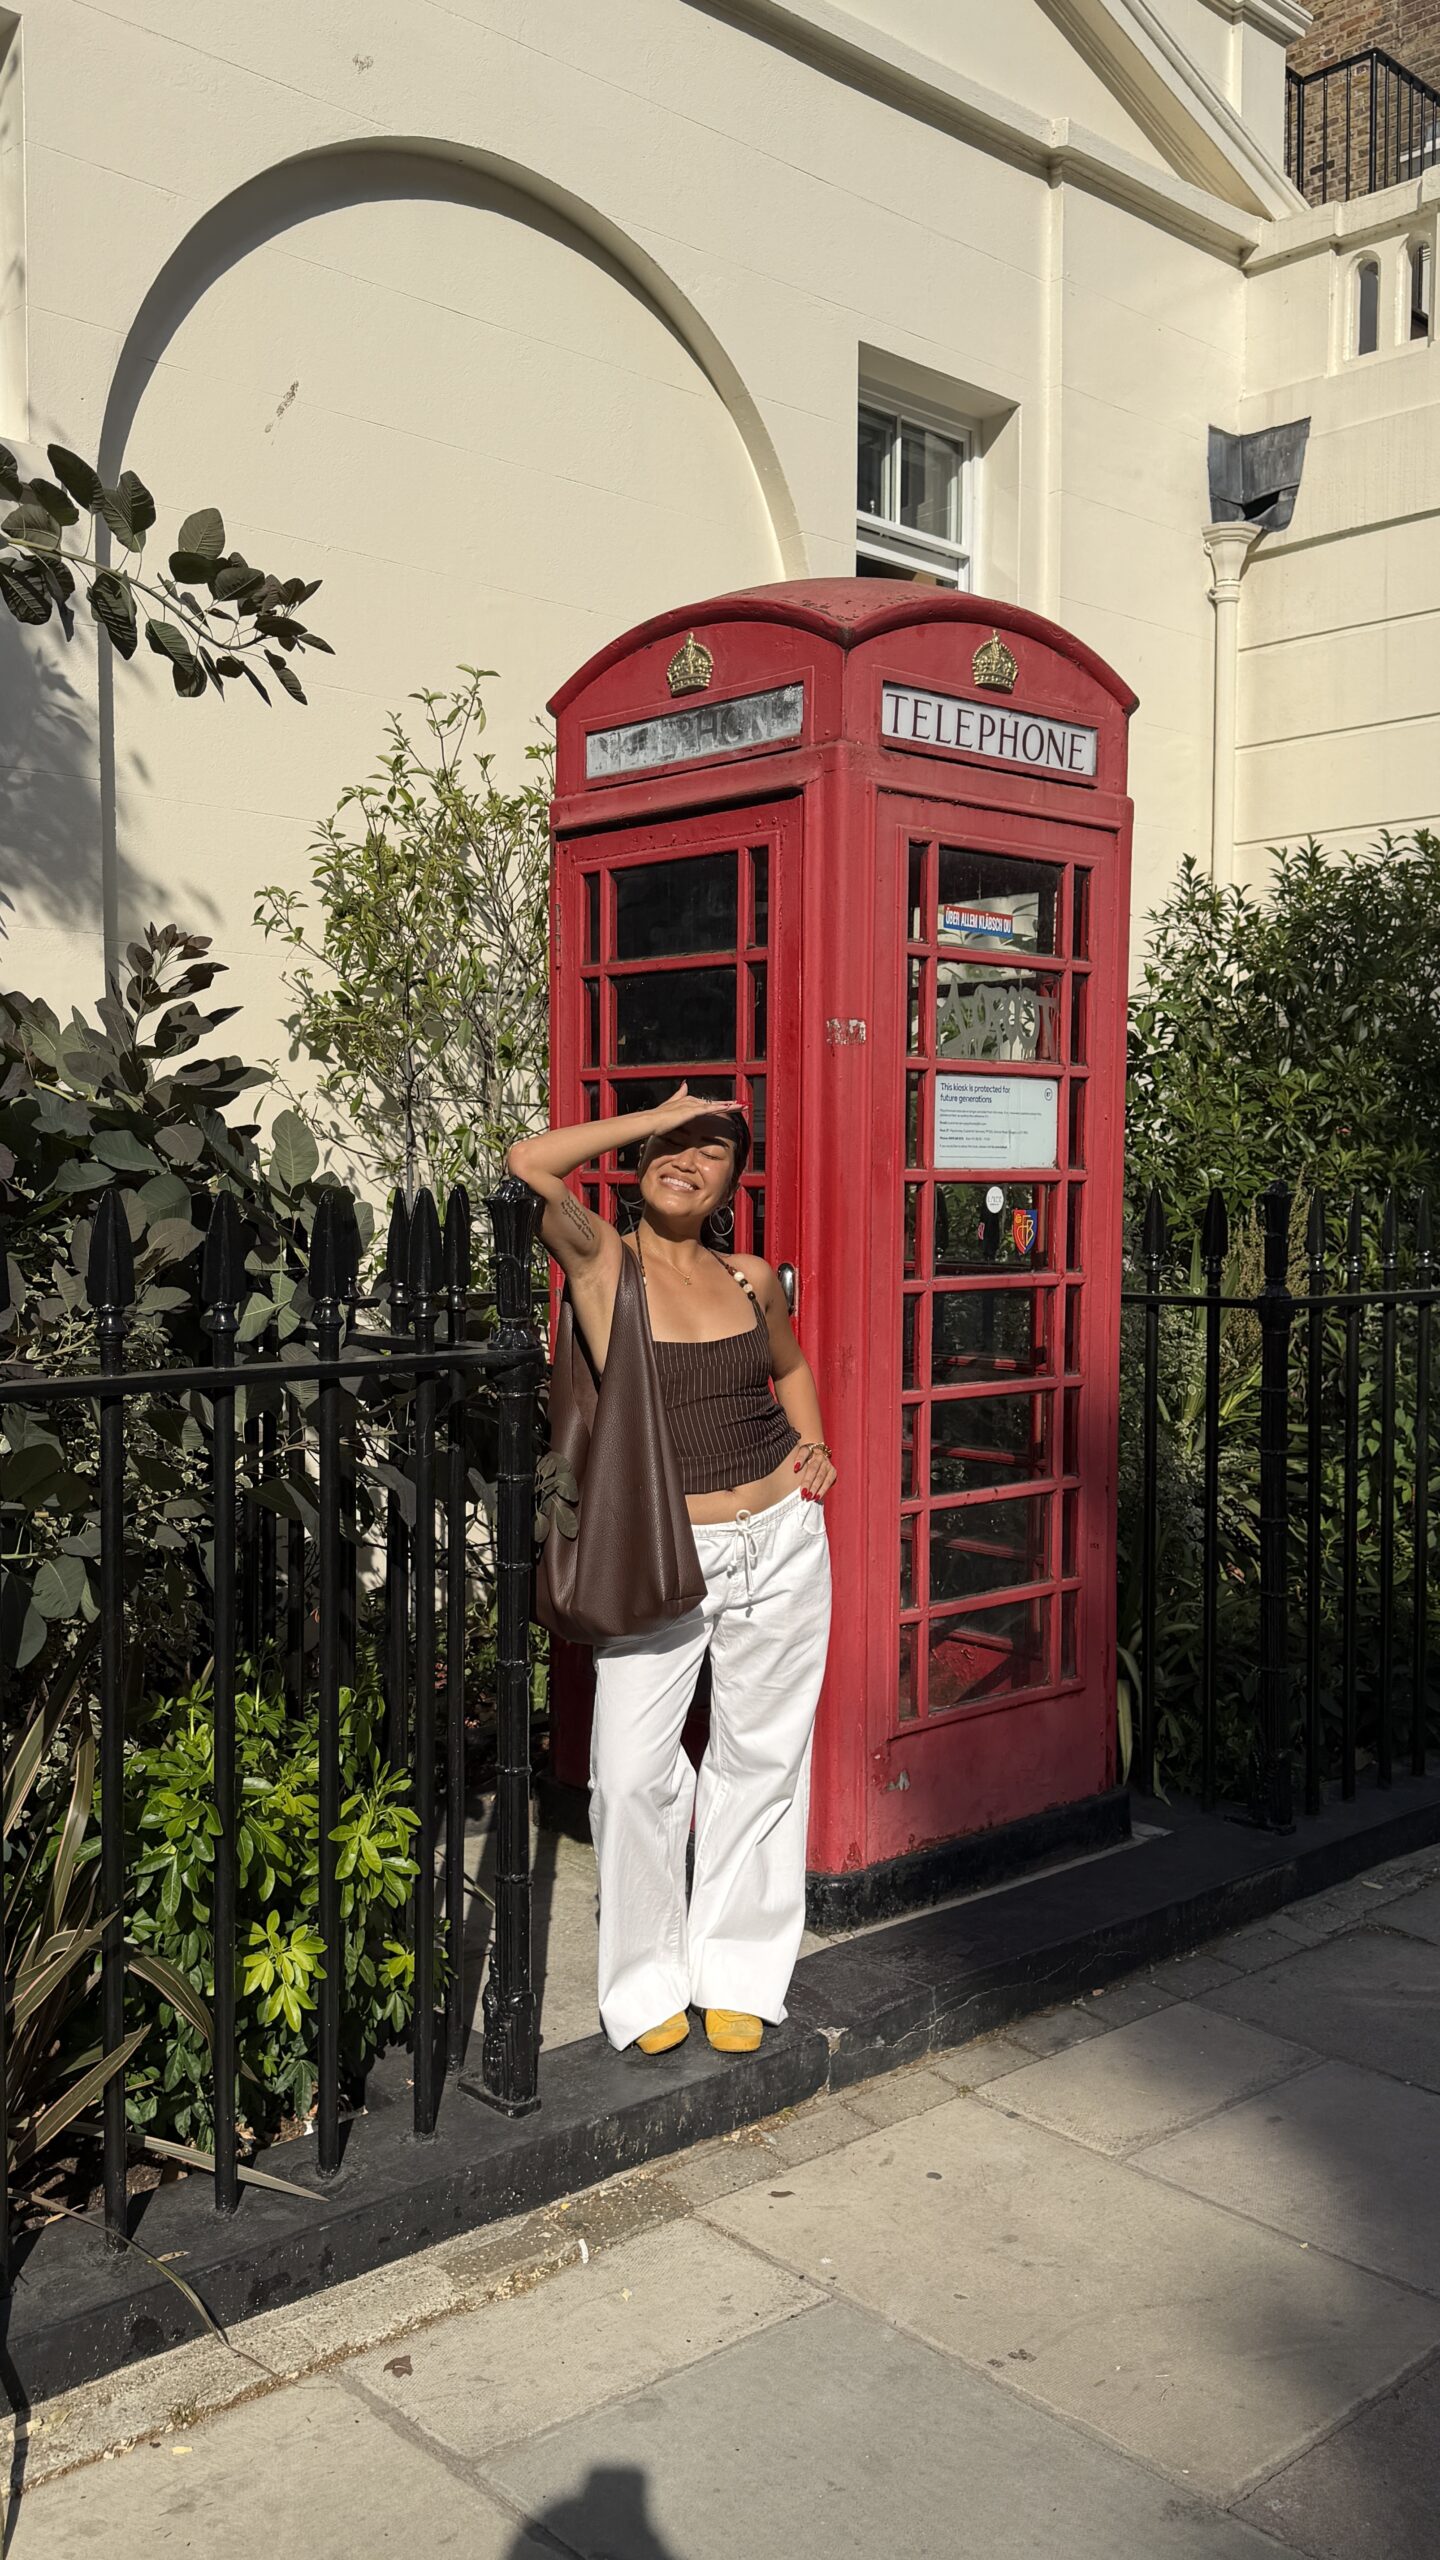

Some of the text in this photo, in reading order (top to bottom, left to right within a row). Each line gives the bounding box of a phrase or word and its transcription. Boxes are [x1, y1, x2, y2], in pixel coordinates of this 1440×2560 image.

[885, 693, 1087, 771] TELEPHONE
[953, 1083, 968, 1091] kiosk
[969, 1084, 974, 1092] is
[974, 1085, 1002, 1093] protected
[1002, 1085, 1010, 1093] for
[940, 1093, 992, 1104] future generations
